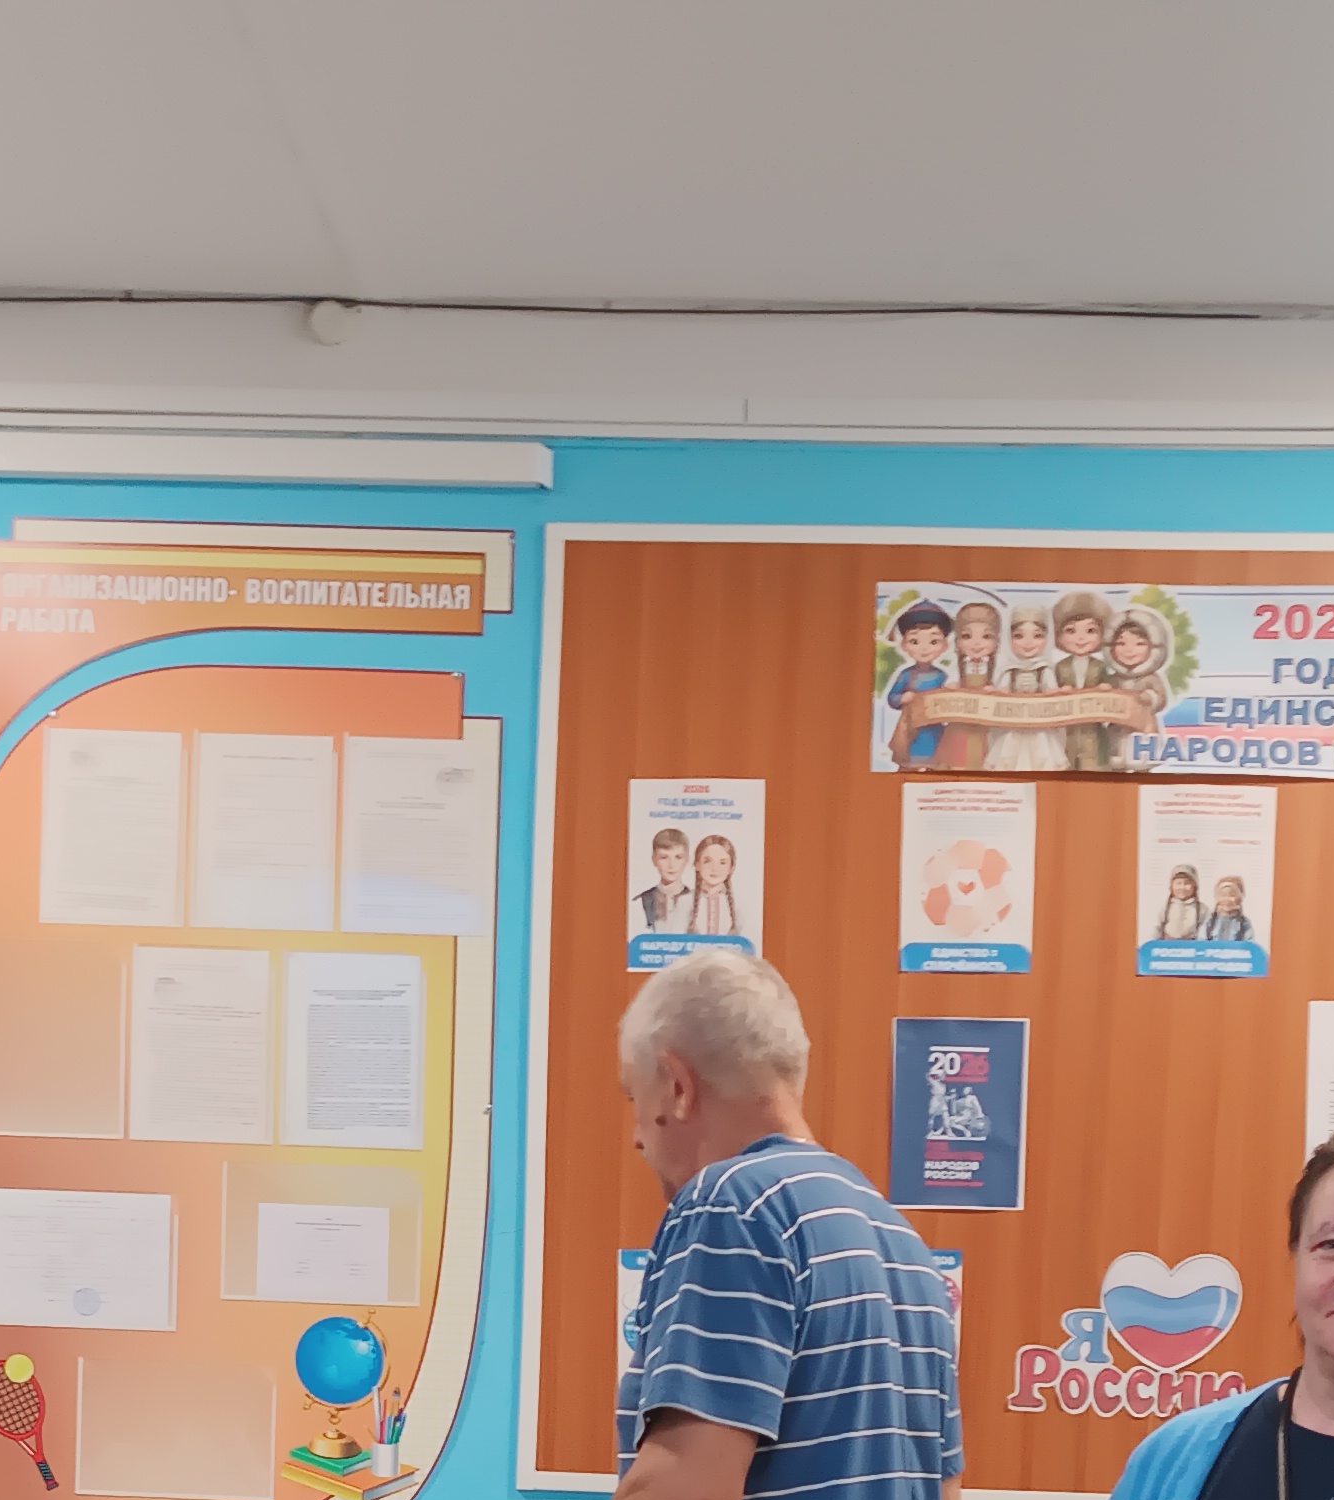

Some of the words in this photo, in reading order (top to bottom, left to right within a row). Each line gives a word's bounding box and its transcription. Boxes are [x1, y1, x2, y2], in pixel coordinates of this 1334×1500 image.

[0, 573, 237, 606] ОРГАНИЗАЦИОННО-
[245, 578, 471, 610] ВОСПИТАТЕЛЬНАЯ
[0, 607, 96, 634] РАБОТА
[1132, 735, 1319, 769] НАРОДОВ
[1061, 1309, 1108, 1363] Я
